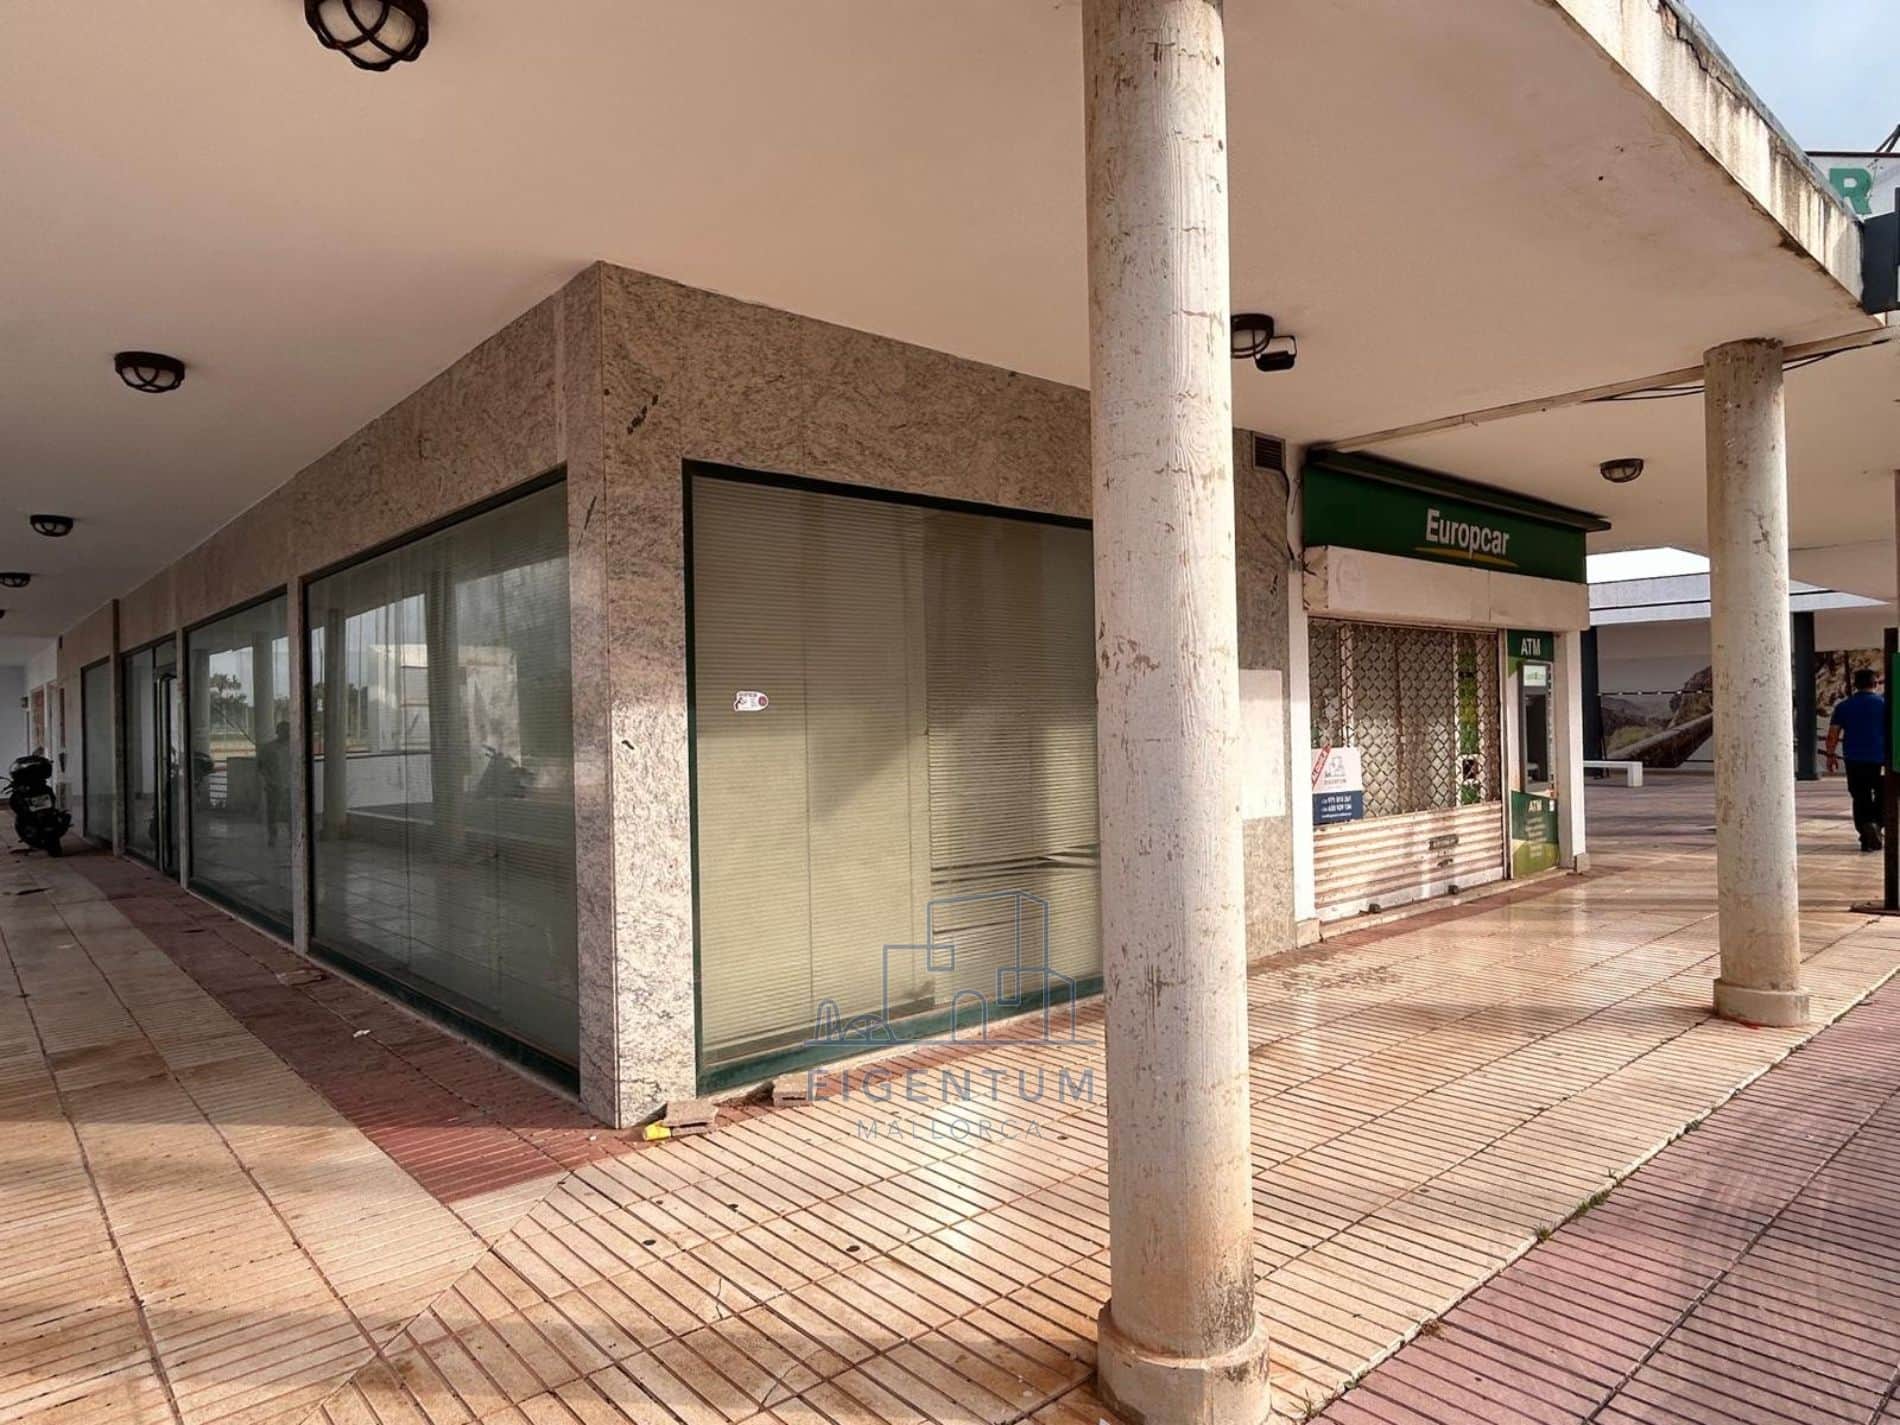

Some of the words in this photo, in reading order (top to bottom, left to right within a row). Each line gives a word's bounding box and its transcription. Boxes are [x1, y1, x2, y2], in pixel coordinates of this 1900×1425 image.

[1425, 508, 1511, 560] Europcar
[1520, 637, 1542, 656] ATM
[1527, 799, 1543, 812] ATM
